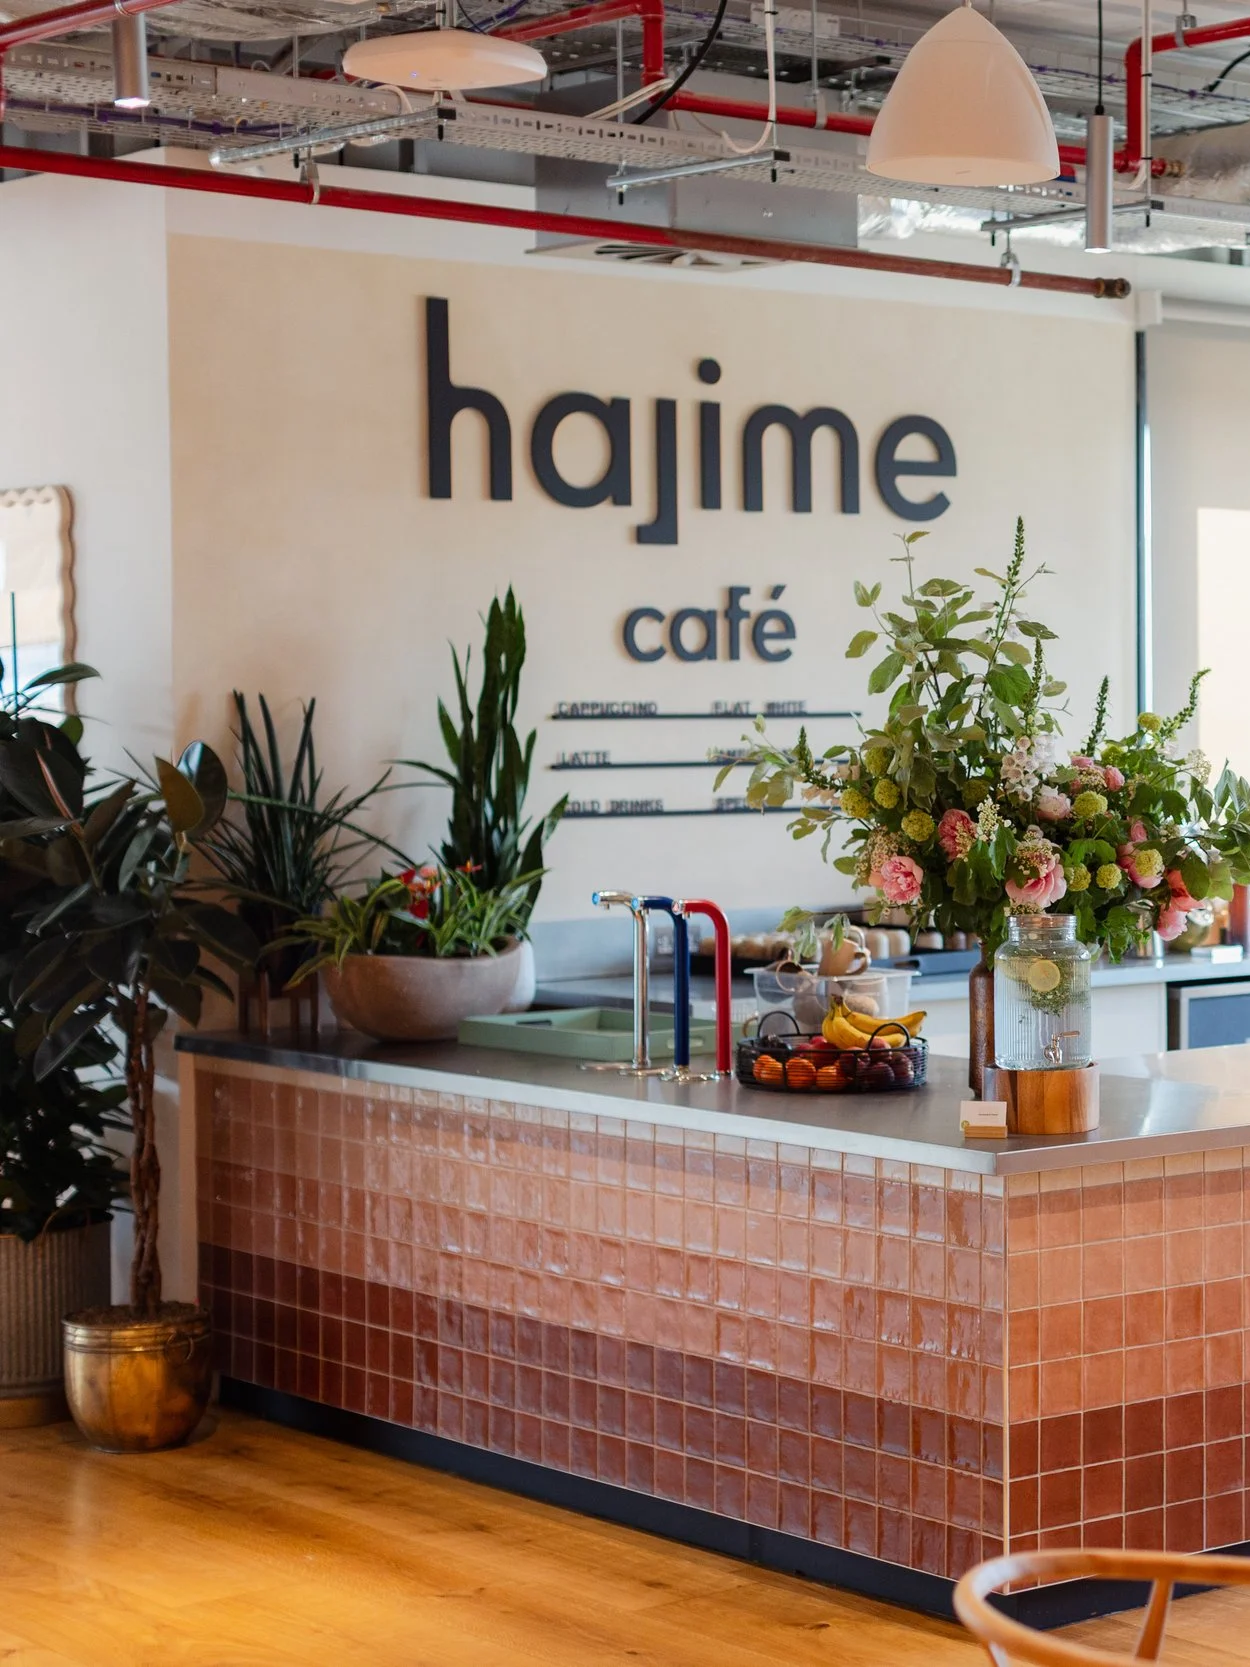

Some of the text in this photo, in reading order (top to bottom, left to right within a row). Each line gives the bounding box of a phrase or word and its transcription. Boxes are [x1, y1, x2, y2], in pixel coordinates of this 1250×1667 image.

[425, 296, 957, 545] hajime
[622, 584, 797, 664] café
[557, 701, 658, 717] CAPPUCCINO
[712, 700, 751, 716] FLAT
[559, 750, 612, 767] LATTE
[607, 798, 664, 815] DRINKS
